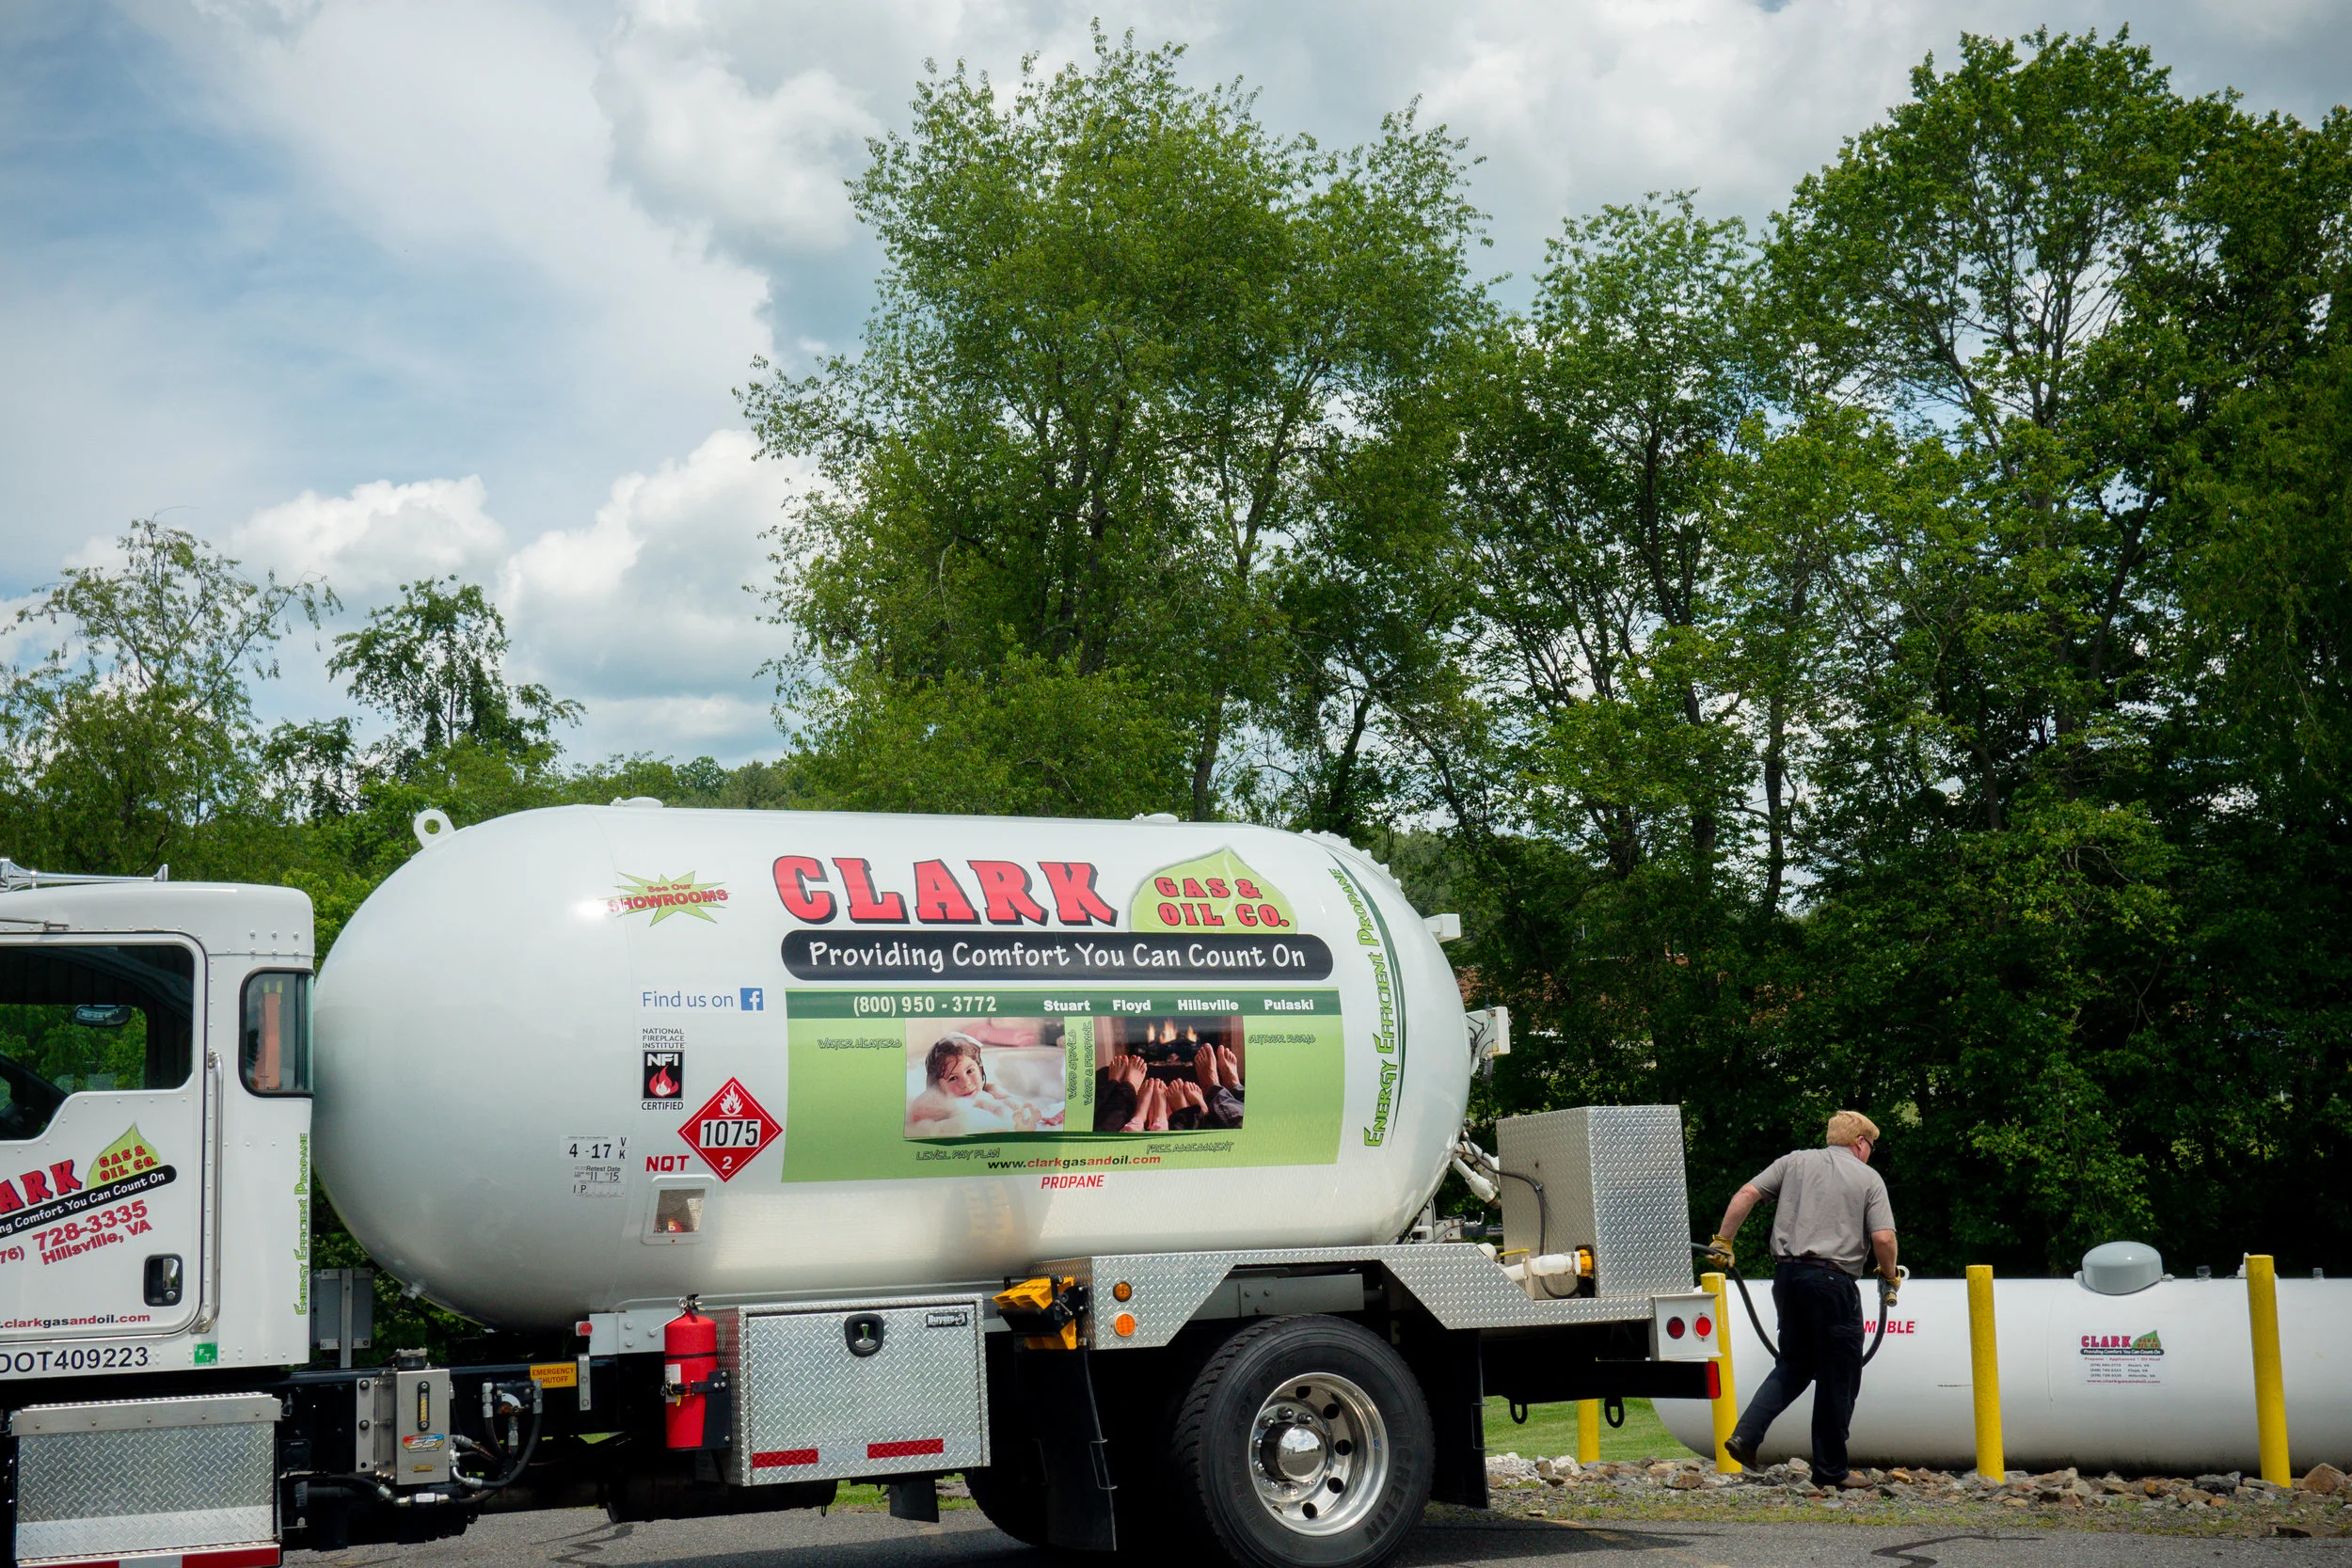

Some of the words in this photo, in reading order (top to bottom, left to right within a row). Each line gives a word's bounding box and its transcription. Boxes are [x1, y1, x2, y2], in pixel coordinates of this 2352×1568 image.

[772, 855, 1119, 927] CLARK
[1154, 877, 1231, 898] GAS
[1234, 878, 1263, 899] &
[607, 889, 729, 913] SHOWROOMS
[1157, 902, 1225, 927] OIL
[1235, 903, 1290, 927] CO.
[809, 942, 945, 973] Providing
[952, 942, 1071, 967] Comfort
[1075, 942, 1125, 967] You
[1133, 942, 1182, 968] Can
[1188, 942, 1266, 968] Count
[1272, 942, 1306, 968] On
[643, 990, 681, 1007] Find
[687, 995, 707, 1007] us
[712, 995, 734, 1007] on
[853, 995, 897, 1017] (800)
[902, 996, 935, 1013] 950
[952, 996, 997, 1013] 3772
[1043, 999, 1091, 1012] Stuart
[1112, 999, 1152, 1013] Floyd
[1178, 999, 1239, 1011] Hillsville
[1264, 999, 1314, 1011] Pulaski
[818, 1037, 854, 1050] WATER
[855, 1037, 902, 1050] HEATERS
[647, 1053, 679, 1067] NFI
[641, 1101, 684, 1111] CERTIFIED
[703, 1120, 758, 1147] 1075
[620, 1137, 627, 1147] V
[1146, 1144, 1171, 1154] FREE
[1172, 1140, 1234, 1153] ASSESSMENT
[99, 1148, 132, 1168] GAS
[135, 1145, 147, 1156] &
[569, 1143, 578, 1158] 4
[619, 1149, 626, 1160] K
[916, 1149, 951, 1161] LEVEL
[952, 1149, 974, 1161] PAY
[974, 1148, 1000, 1159] PLAN
[100, 1165, 129, 1181] OIL
[134, 1156, 158, 1171] CO.
[722, 1156, 733, 1169] 2
[988, 1155, 1161, 1169] www.clarkgasandoil.com
[1041, 1175, 1104, 1190] PROPANE
[14, 1205, 64, 1228] Comfort
[65, 1197, 87, 1211] You
[89, 1190, 111, 1203] Can
[113, 1178, 148, 1196] Count
[149, 1172, 165, 1184] On
[32, 1199, 148, 1251] 728-3335
[41, 1232, 124, 1266] Hillsville,
[125, 1219, 153, 1236] VA
[0, 1313, 151, 1329] .clarkgasandoil.com
[2081, 1336, 2131, 1348] CLARK
[532, 1367, 575, 1376] EMERGENCY
